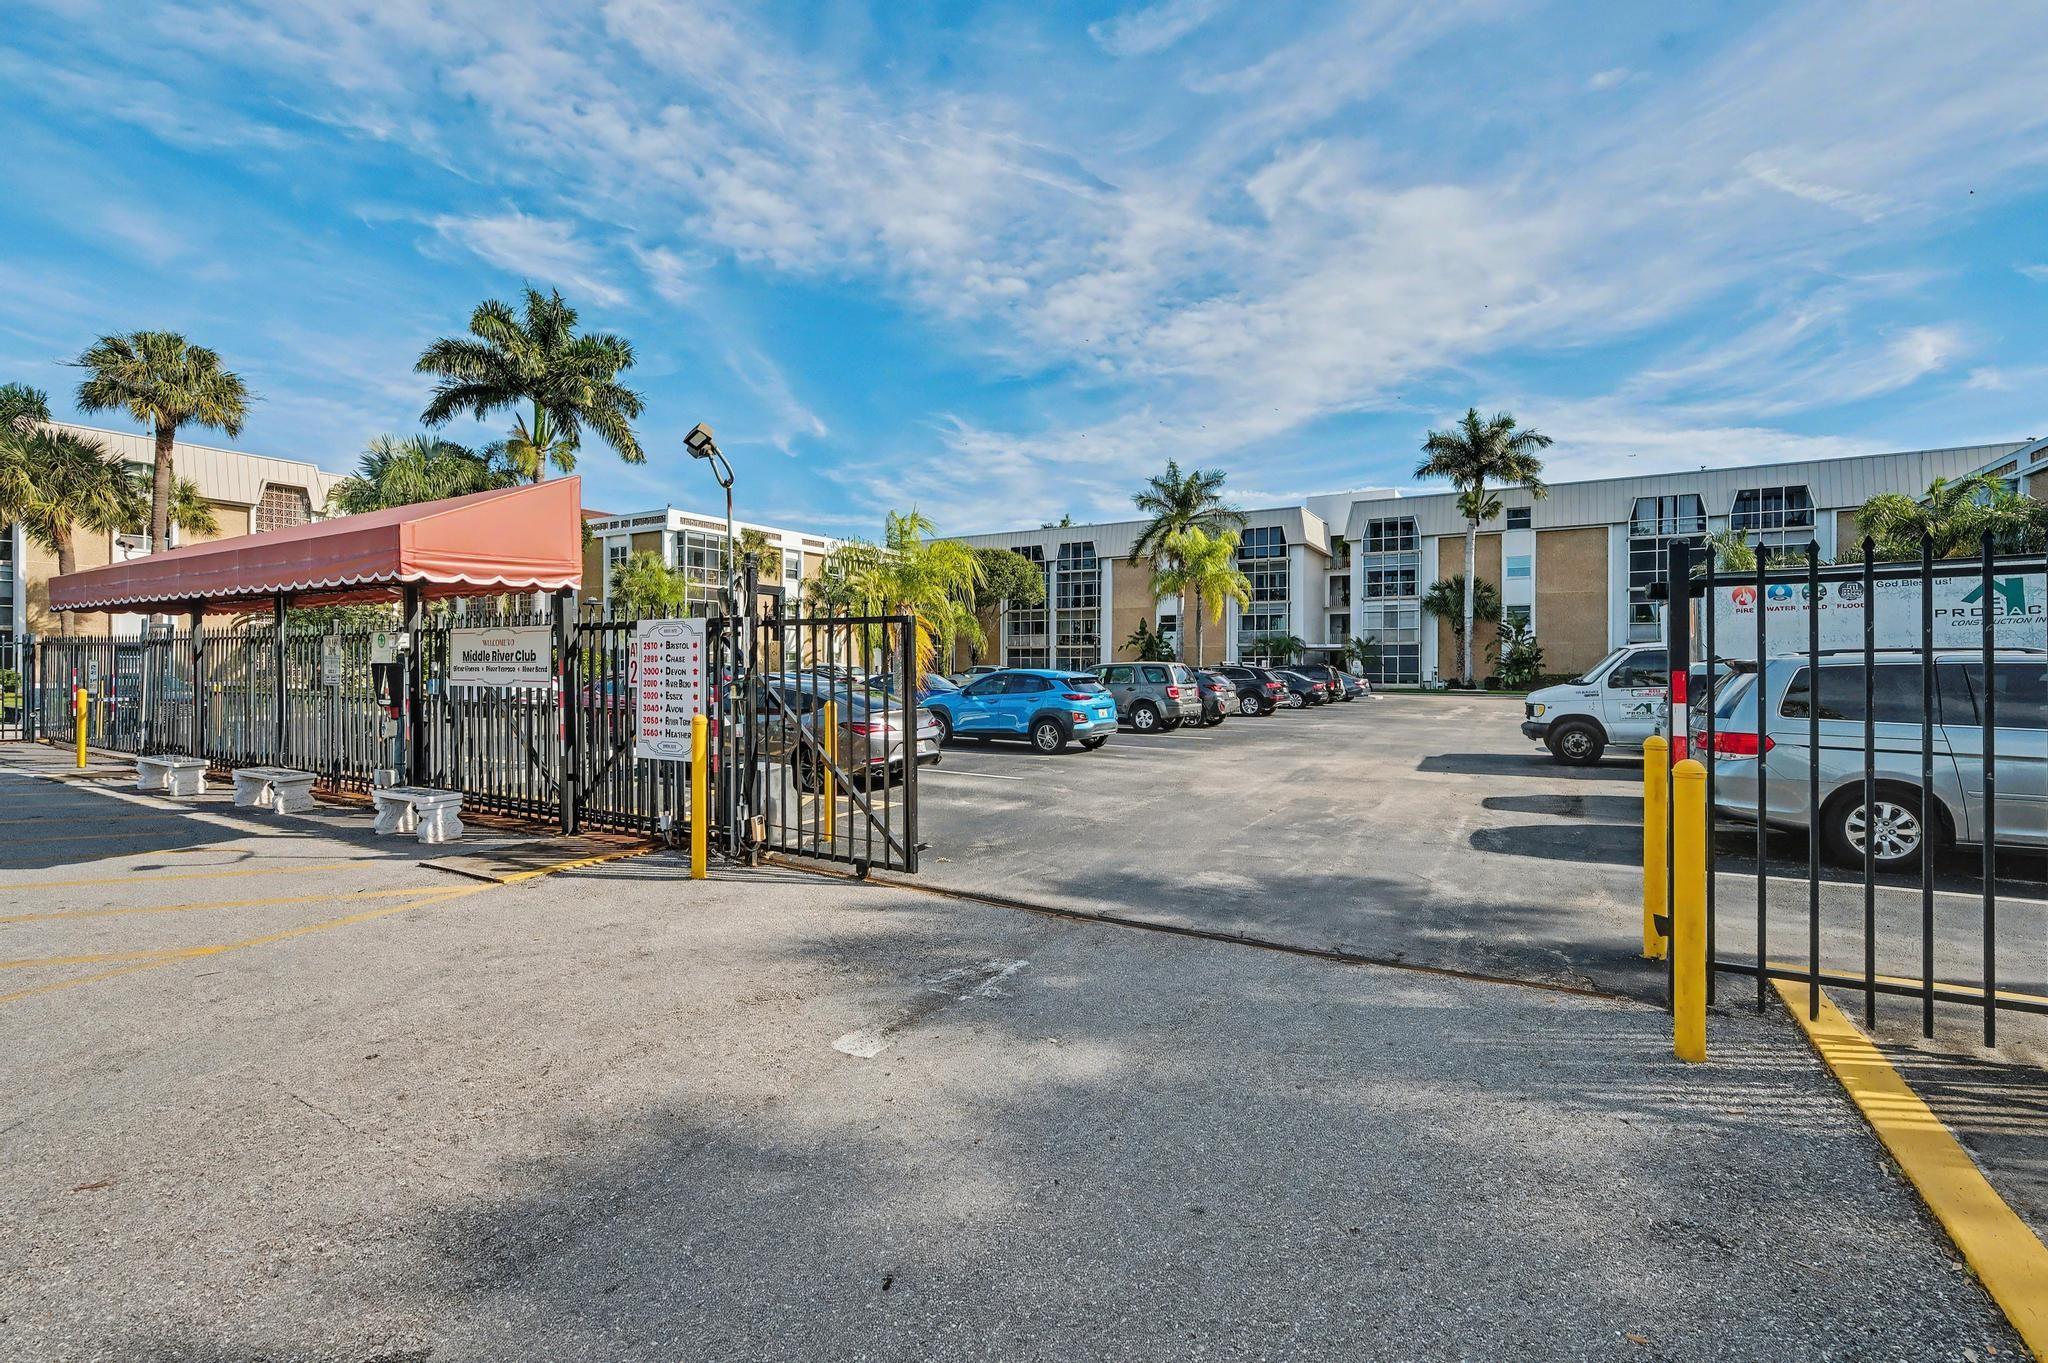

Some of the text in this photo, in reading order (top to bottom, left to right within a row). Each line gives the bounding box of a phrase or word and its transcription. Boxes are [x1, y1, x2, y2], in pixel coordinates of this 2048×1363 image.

[1876, 577, 1951, 589] God Bles us!
[462, 649, 537, 662] Middle River Club
[666, 654, 685, 663] CHASE
[666, 666, 686, 675] DEVON
[666, 691, 683, 701] ESSEX
[666, 703, 683, 714] AVON
[666, 728, 691, 739] HEATHER
